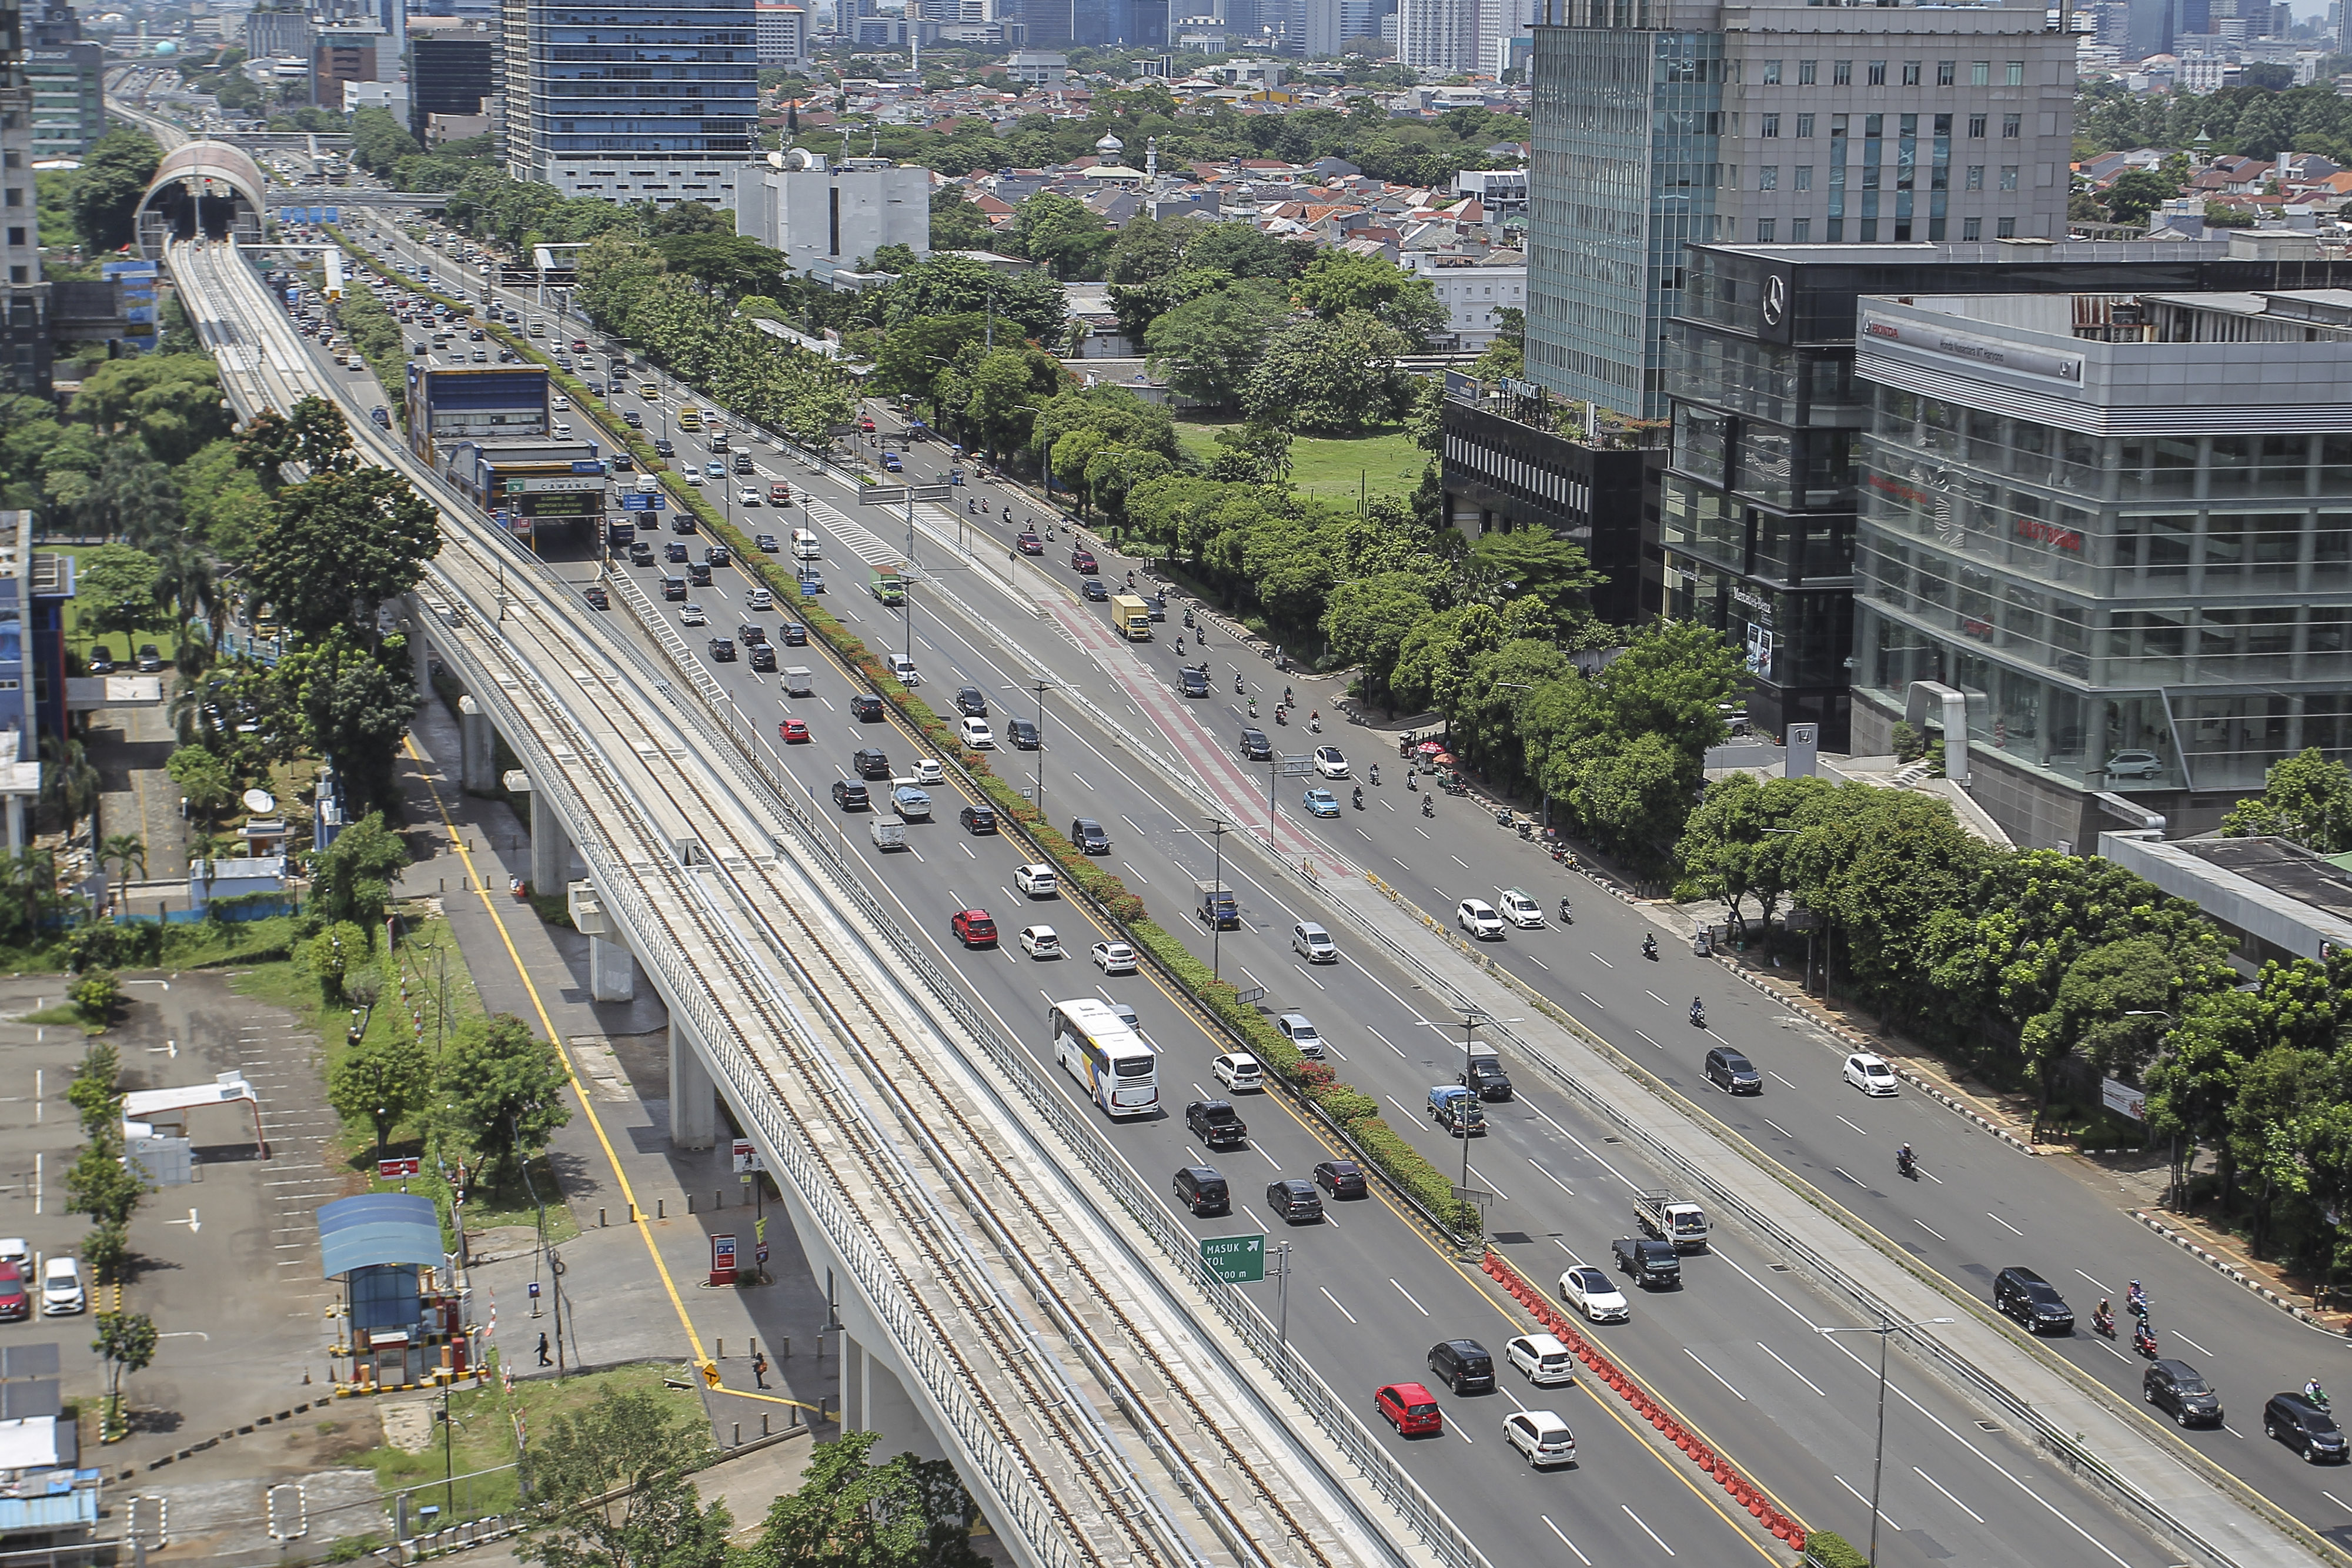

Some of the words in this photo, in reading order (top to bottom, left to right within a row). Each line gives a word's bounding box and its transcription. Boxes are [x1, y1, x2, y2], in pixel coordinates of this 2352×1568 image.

[1872, 323, 1899, 339] HONDA
[1939, 339, 1954, 351] Honda
[1733, 586, 1772, 614] Mercedes-Benz
[1207, 1243, 1240, 1255] MASUK
[1207, 1257, 1224, 1266] TOL
